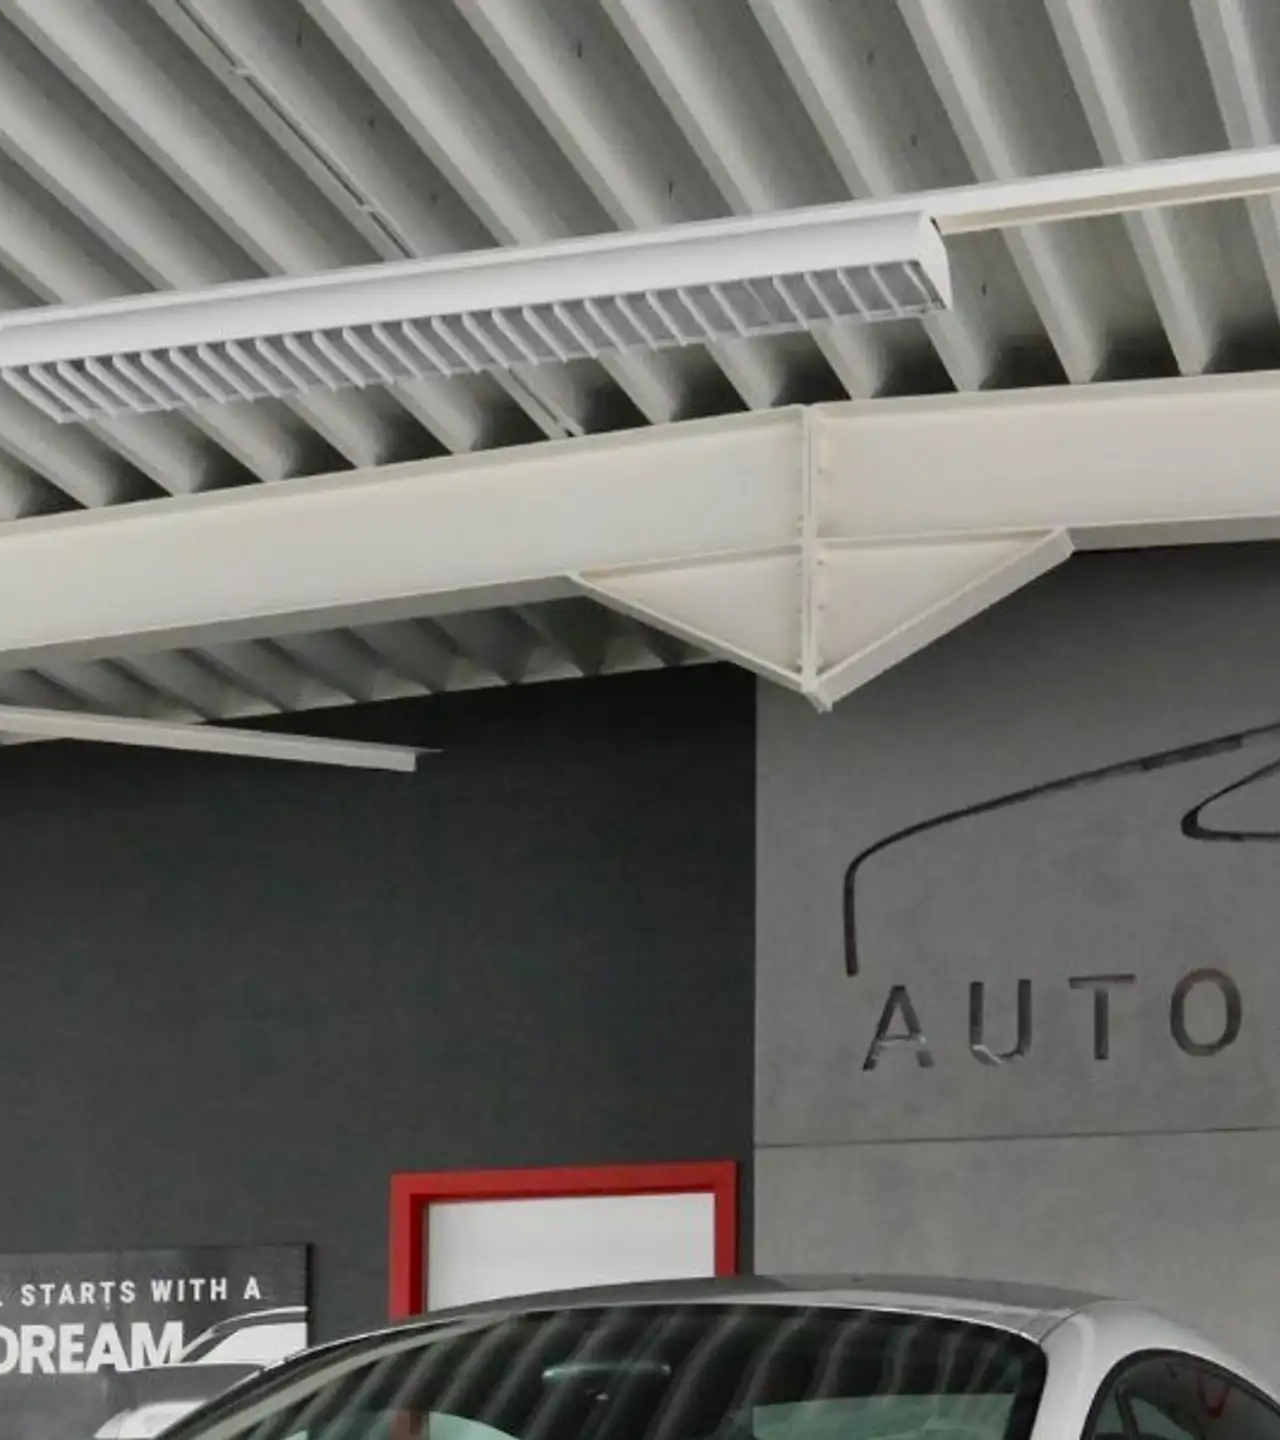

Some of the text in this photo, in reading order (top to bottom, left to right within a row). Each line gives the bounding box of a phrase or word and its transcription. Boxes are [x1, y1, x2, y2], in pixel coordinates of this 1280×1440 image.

[20, 1280, 137, 1308] STARTS
[151, 1276, 228, 1303] WITH
[243, 1275, 262, 1300] A
